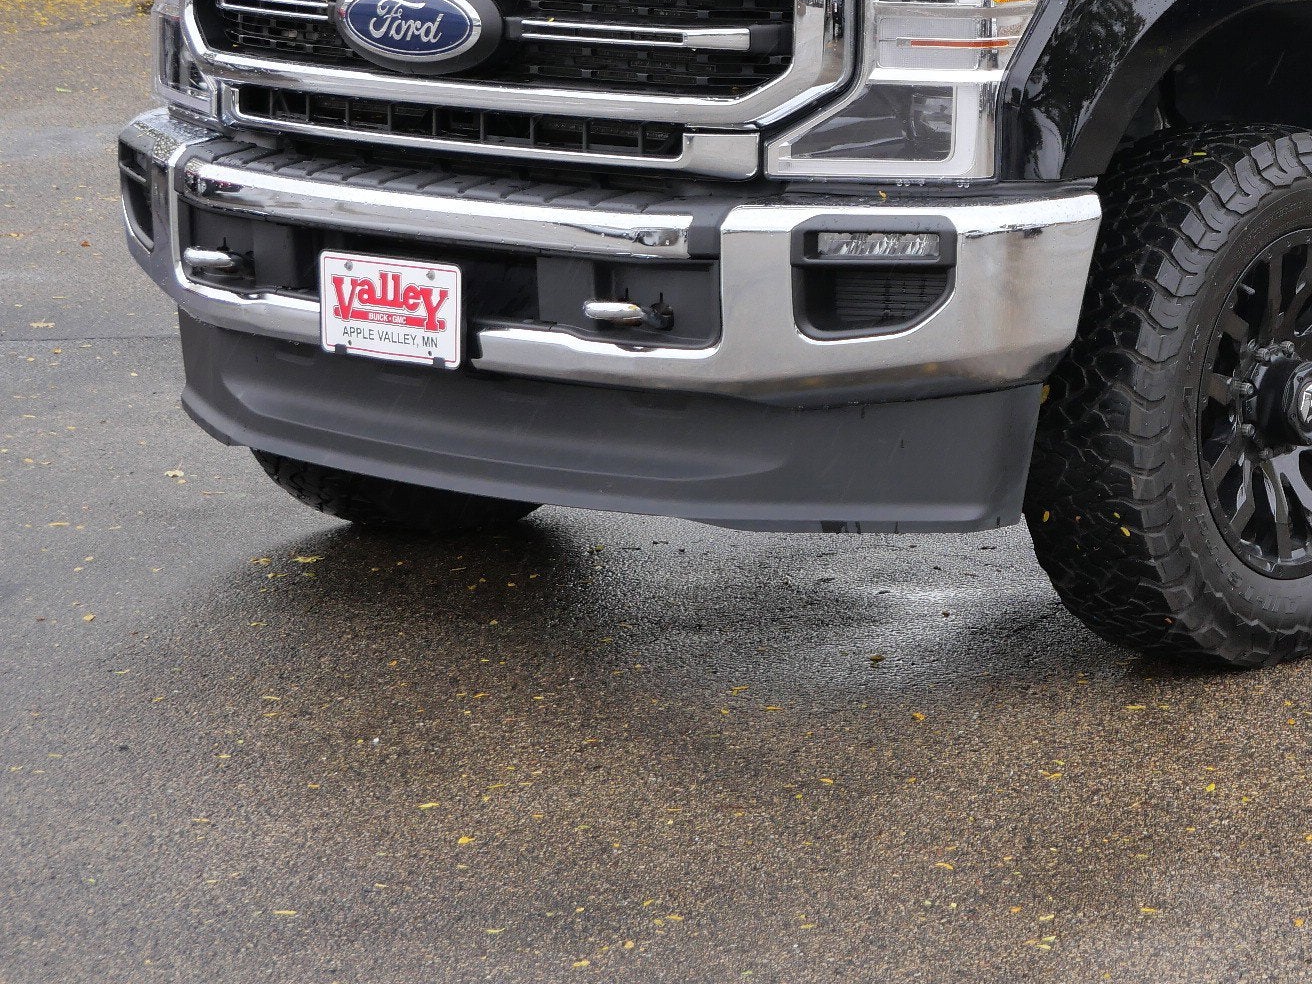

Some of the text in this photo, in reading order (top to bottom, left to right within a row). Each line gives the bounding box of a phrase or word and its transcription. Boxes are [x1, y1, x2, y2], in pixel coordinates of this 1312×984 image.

[368, 312, 407, 324] BUICK GMC
[342, 325, 438, 348] APPLE VALLEY, MN
